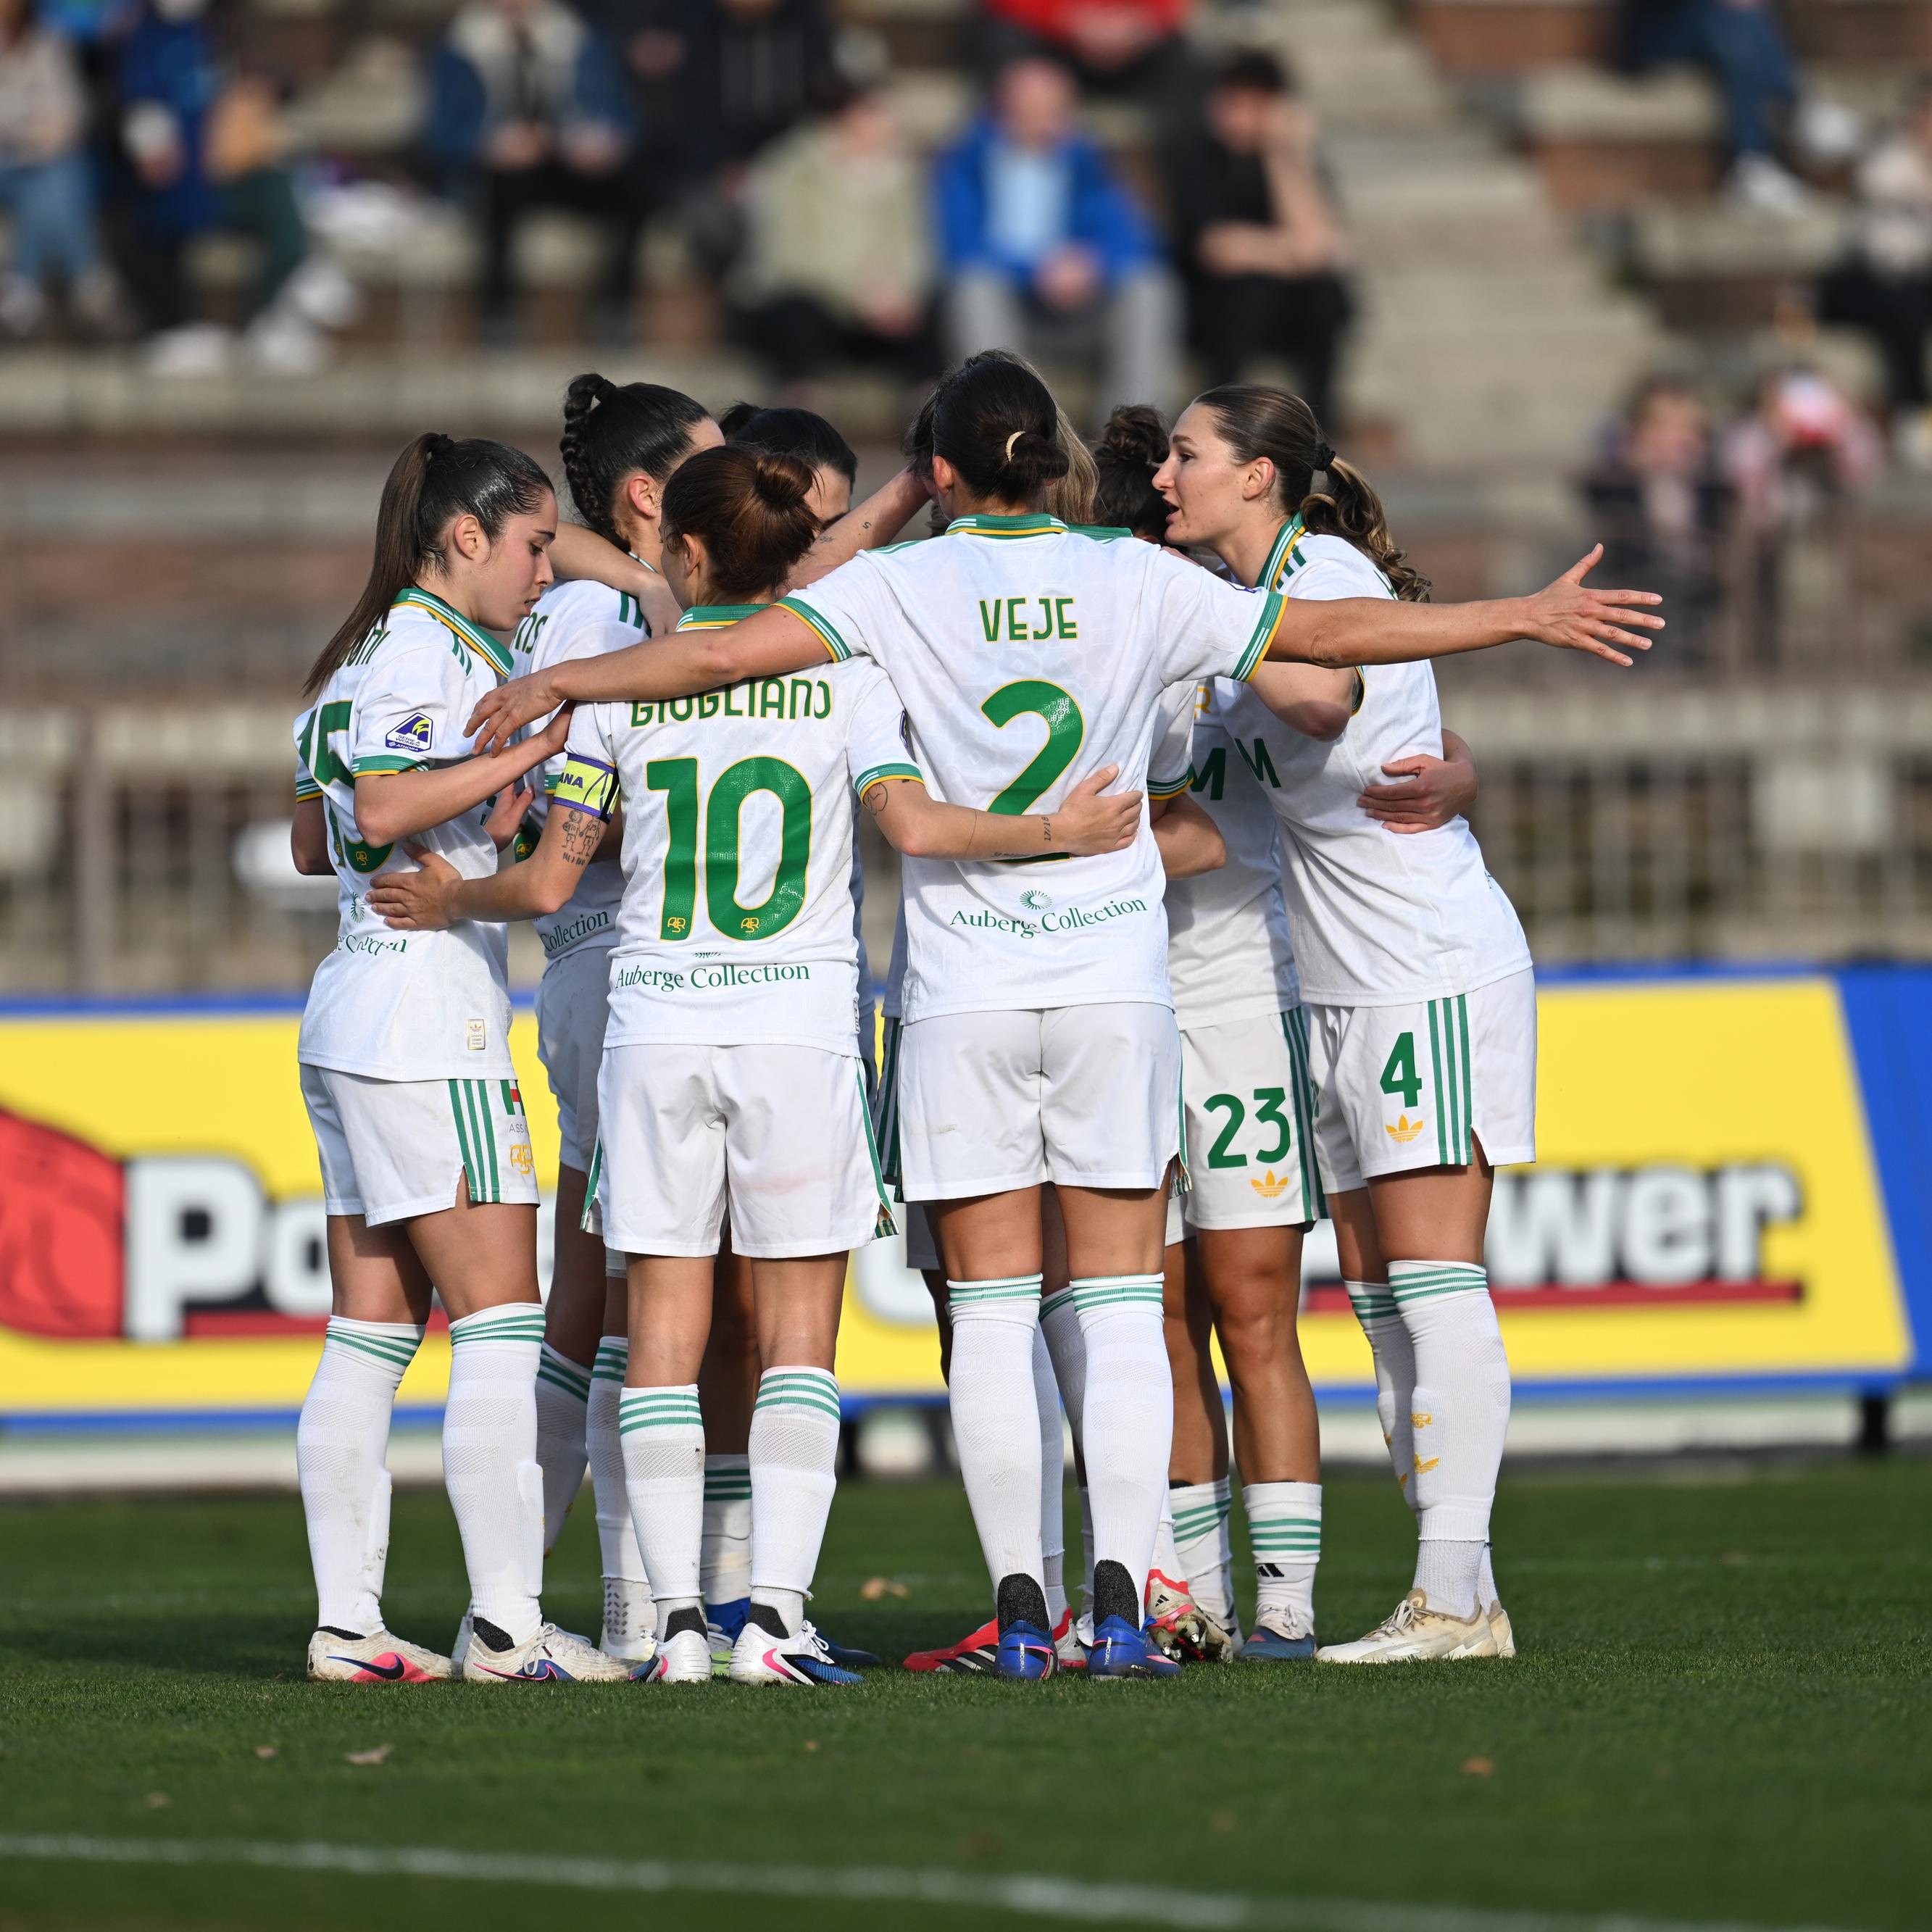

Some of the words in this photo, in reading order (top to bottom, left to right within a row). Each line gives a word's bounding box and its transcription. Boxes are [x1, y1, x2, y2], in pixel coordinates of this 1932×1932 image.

[979, 596, 1078, 642] VEJE
[630, 676, 832, 728] GIUGLIANO
[395, 737, 420, 747] WOMEN
[398, 735, 416, 744] SERIE
[557, 771, 583, 789] ANA
[980, 678, 1086, 863] 2
[646, 754, 814, 942] 10
[539, 910, 609, 952] Collection
[1041, 898, 1149, 933] Collection
[615, 965, 685, 993] Auberge
[690, 962, 811, 989] Collection
[1379, 1031, 1423, 1109] 4
[1202, 1086, 1291, 1170] 23
